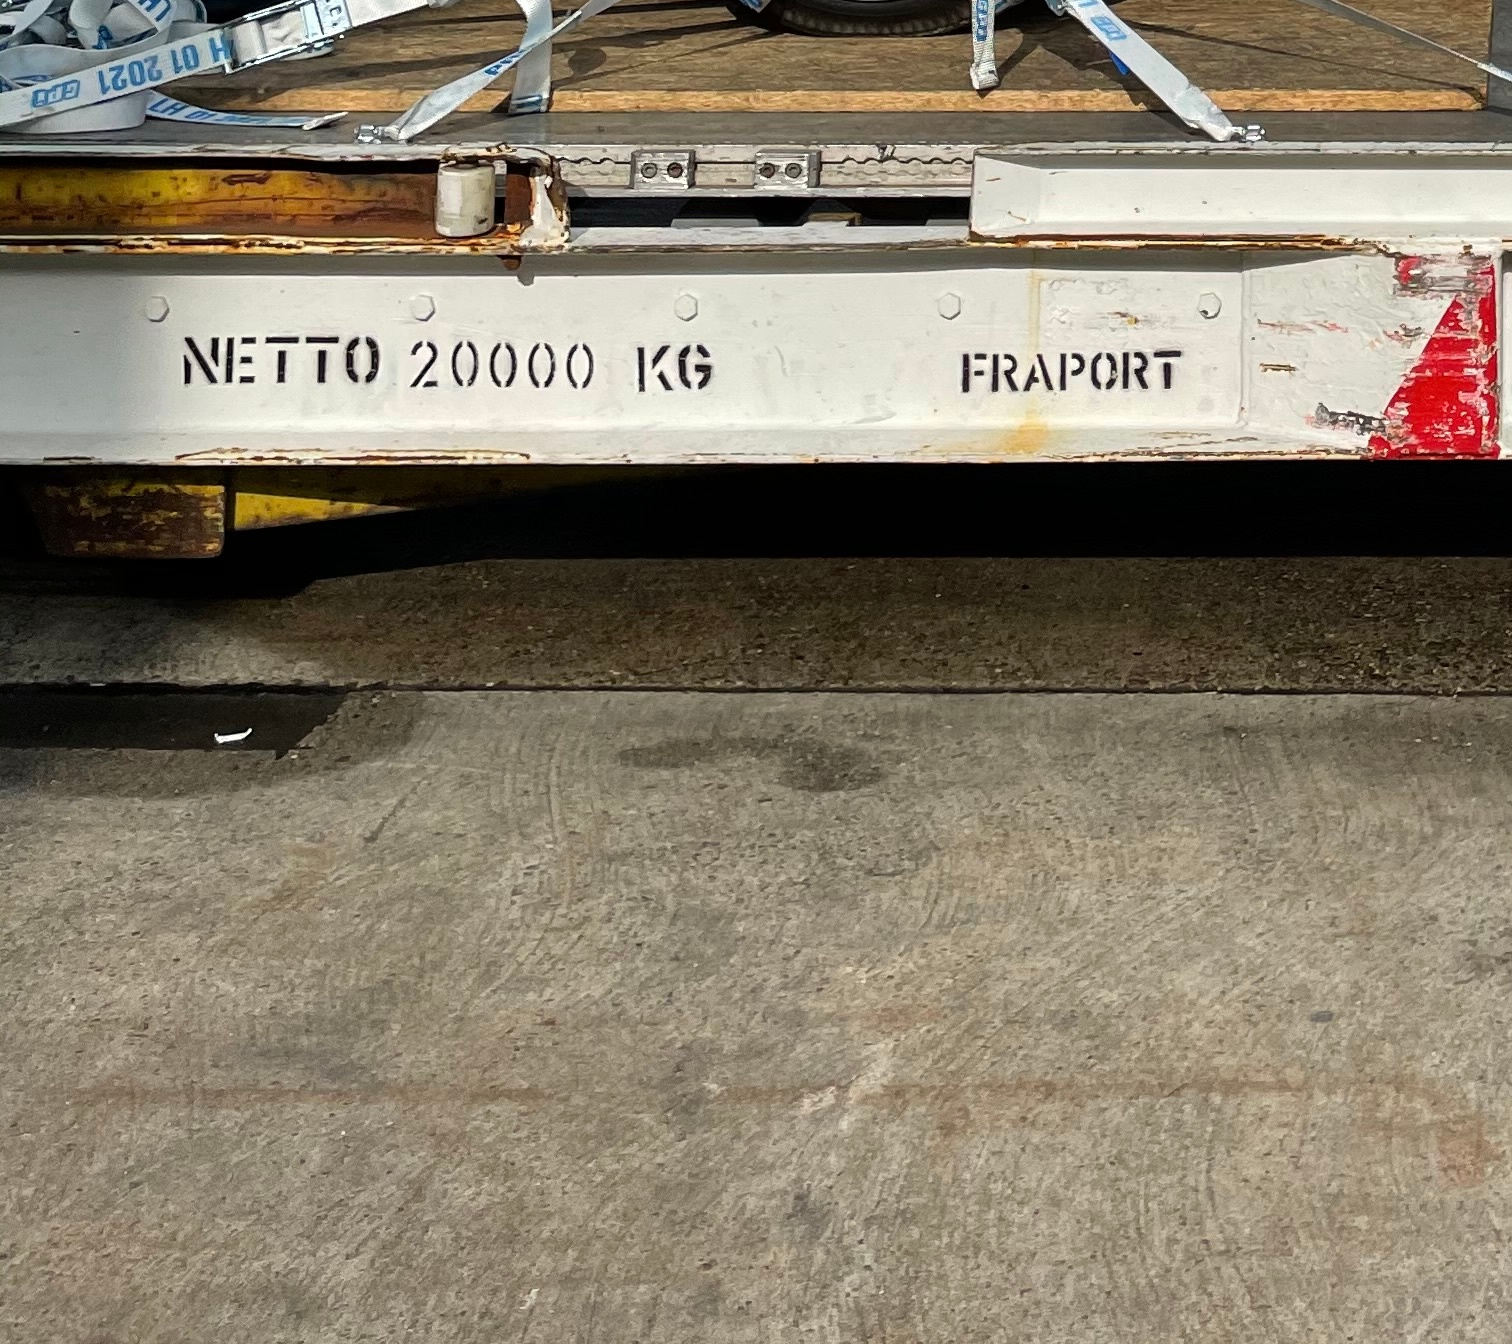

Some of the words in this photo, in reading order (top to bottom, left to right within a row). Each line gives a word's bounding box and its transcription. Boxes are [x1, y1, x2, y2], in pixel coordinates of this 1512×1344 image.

[98, 55, 164, 95] 2021
[170, 44, 199, 74] 01
[183, 335, 380, 386] NETTO
[410, 340, 595, 390] 20000
[636, 344, 713, 393] KG
[960, 350, 1182, 394] FRAPORT
